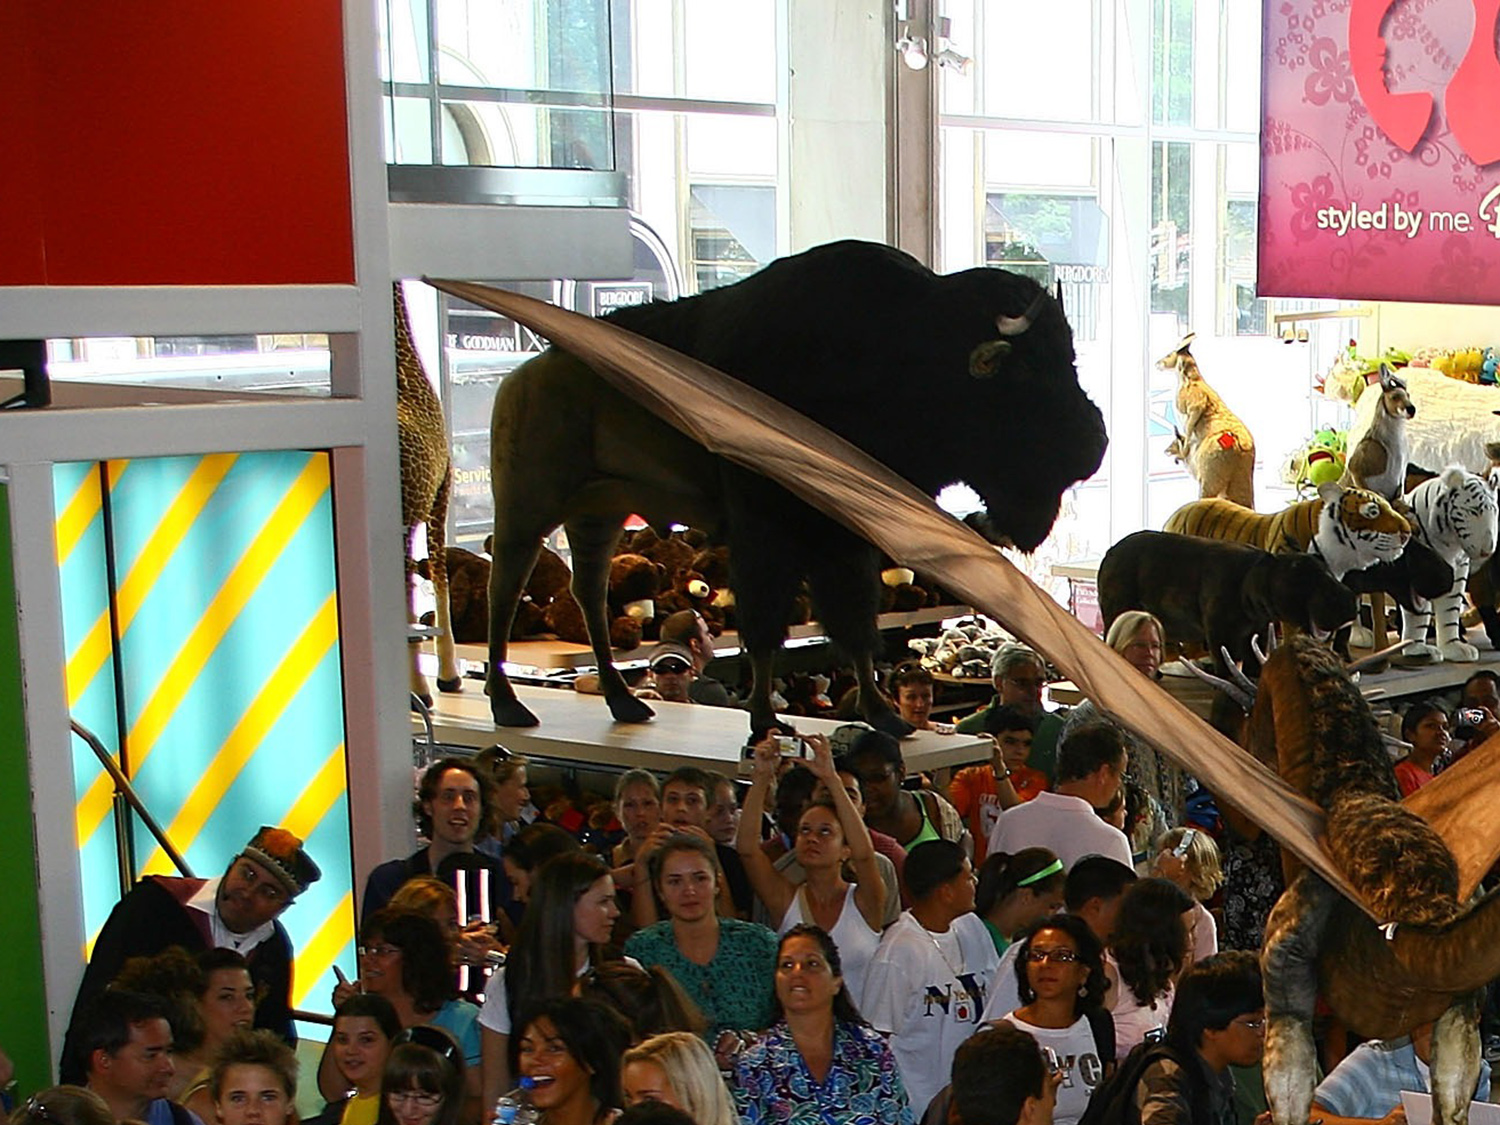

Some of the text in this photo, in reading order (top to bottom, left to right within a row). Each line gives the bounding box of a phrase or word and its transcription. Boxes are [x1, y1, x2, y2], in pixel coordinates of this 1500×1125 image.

[1316, 202, 1388, 237] styled
[1393, 203, 1423, 239] by
[1429, 211, 1475, 233] me.
[463, 335, 515, 352] GOODMAN
